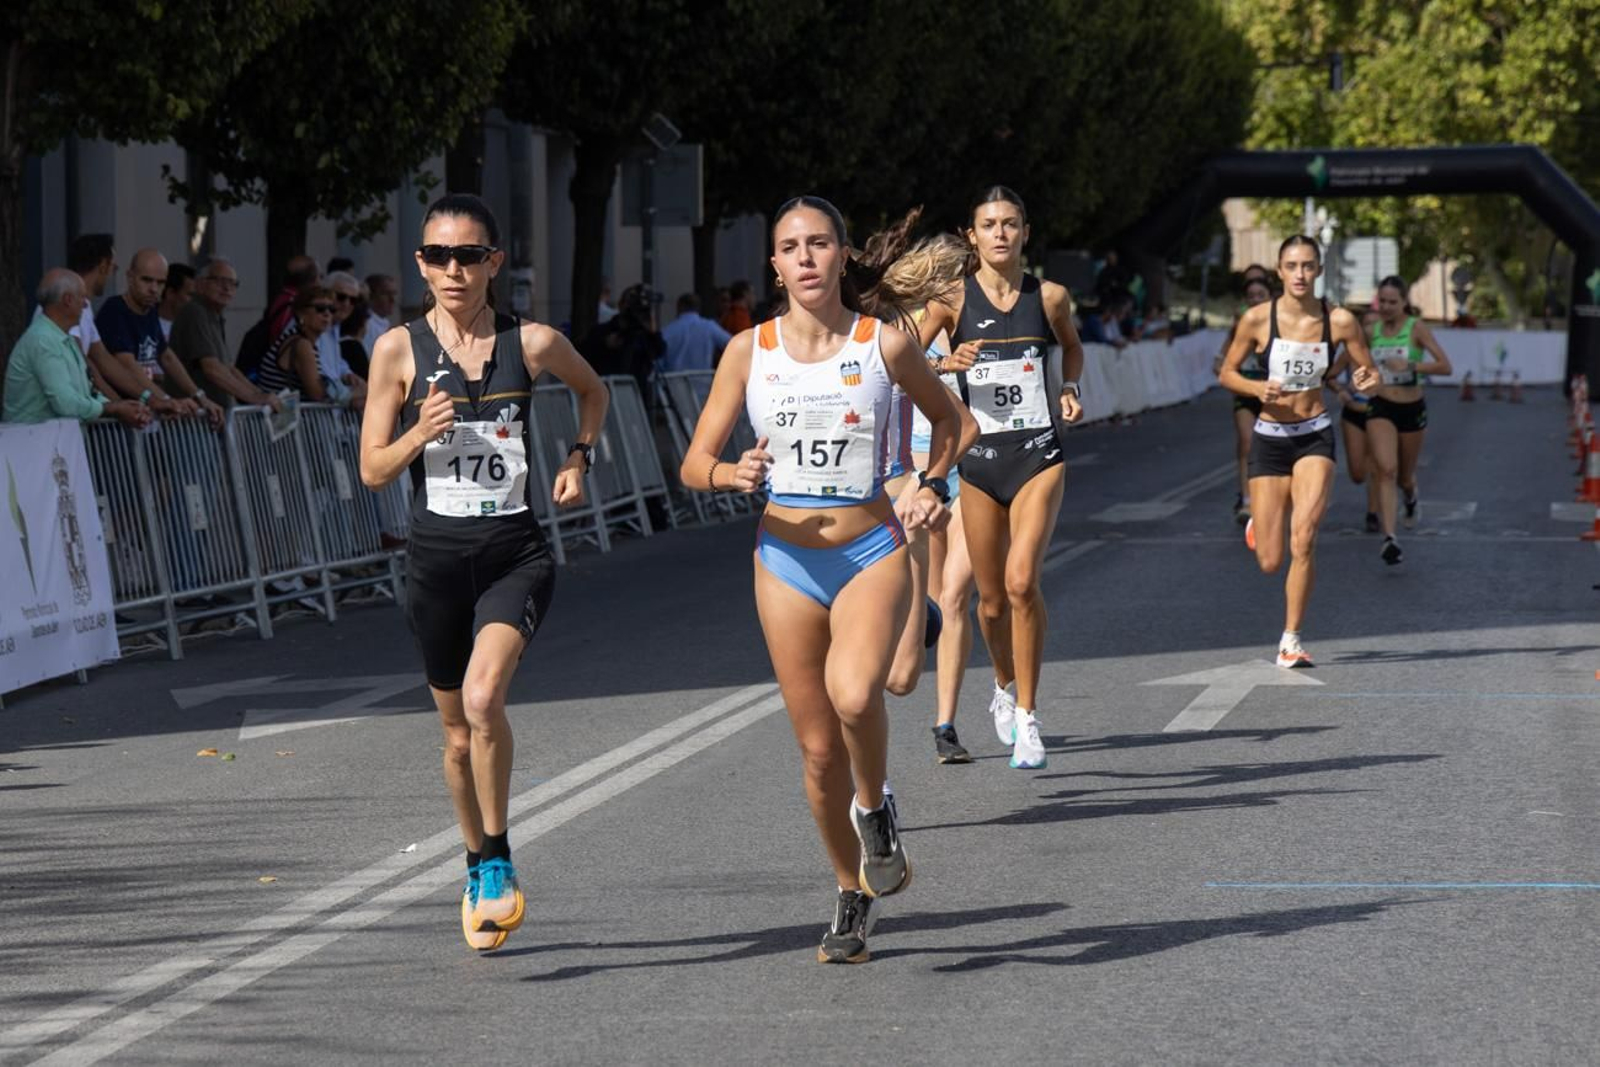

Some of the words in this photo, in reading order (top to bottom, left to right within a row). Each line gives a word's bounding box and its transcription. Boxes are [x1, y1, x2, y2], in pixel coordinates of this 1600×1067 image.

[975, 367, 990, 380] 37
[1283, 360, 1314, 376] 153
[994, 384, 1022, 407] 58
[776, 412, 797, 427] 37
[790, 439, 849, 467] 157
[447, 453, 506, 483] 176
